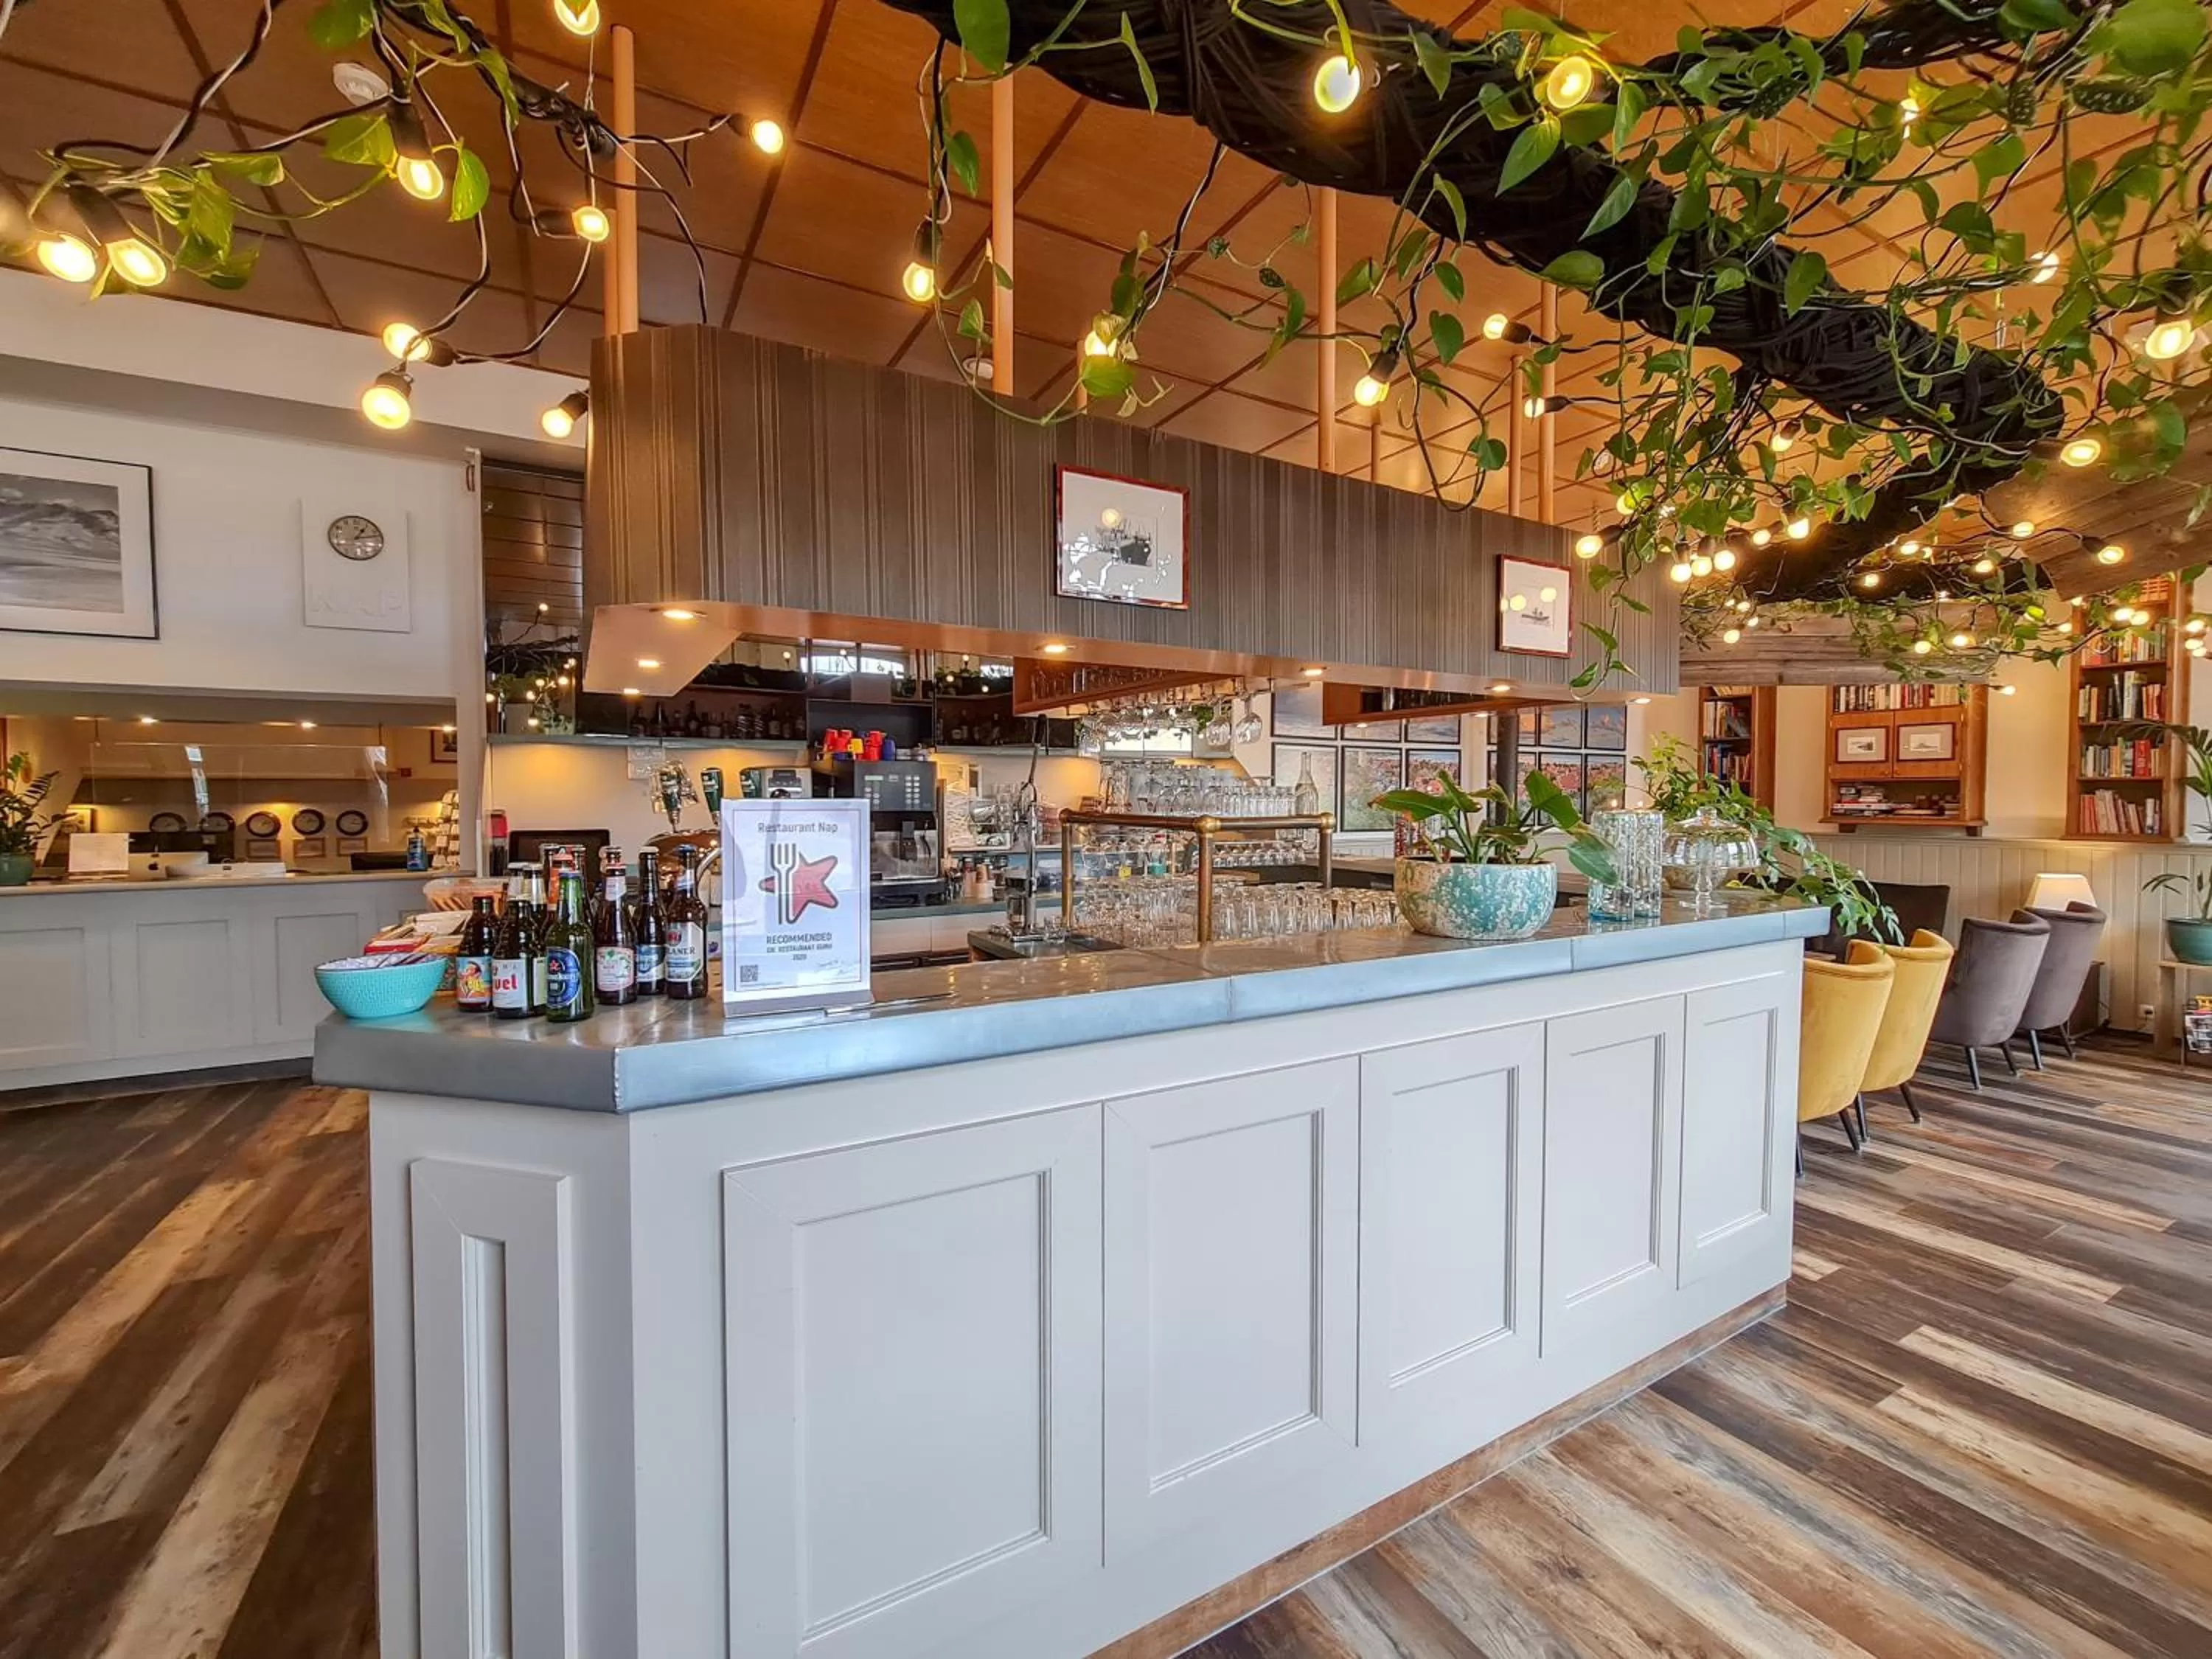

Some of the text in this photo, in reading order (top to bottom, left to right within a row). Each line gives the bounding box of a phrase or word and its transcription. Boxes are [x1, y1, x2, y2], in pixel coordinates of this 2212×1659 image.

[757, 821, 838, 833] Restaurant Nap
[766, 932, 832, 945] RECOMMENDED
[667, 947, 695, 956] LANER
[779, 945, 815, 953] RESTAURANT
[494, 973, 518, 990] vel
